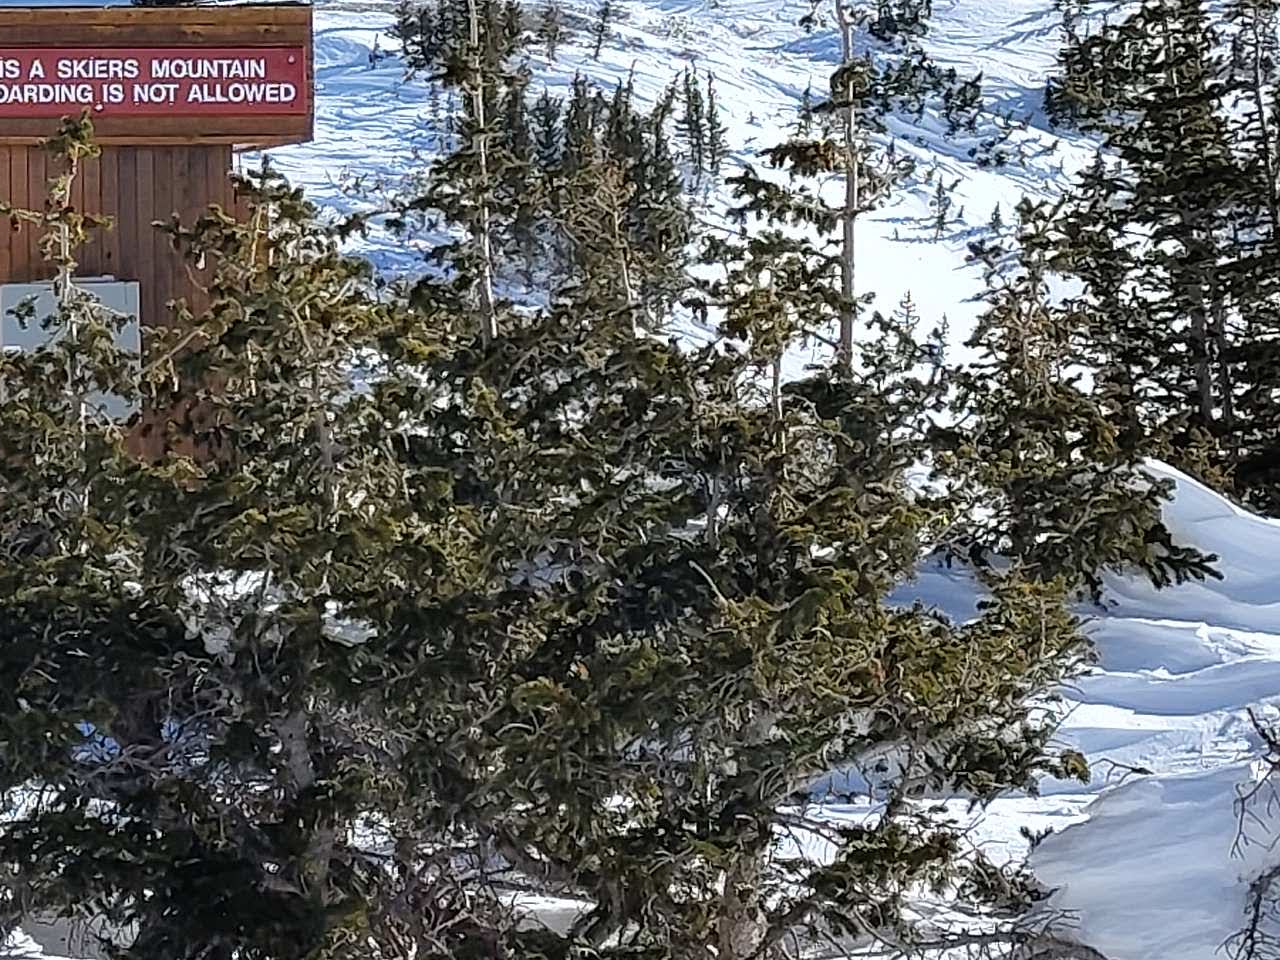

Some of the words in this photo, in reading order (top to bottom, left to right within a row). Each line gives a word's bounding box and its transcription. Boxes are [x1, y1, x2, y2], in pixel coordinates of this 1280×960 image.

[29, 59, 44, 79] A
[57, 58, 139, 79] SKIERS
[151, 59, 266, 79] MOUNTAIN
[102, 84, 124, 103] IS
[134, 84, 179, 103] NOT
[187, 84, 296, 103] ALLOWED
